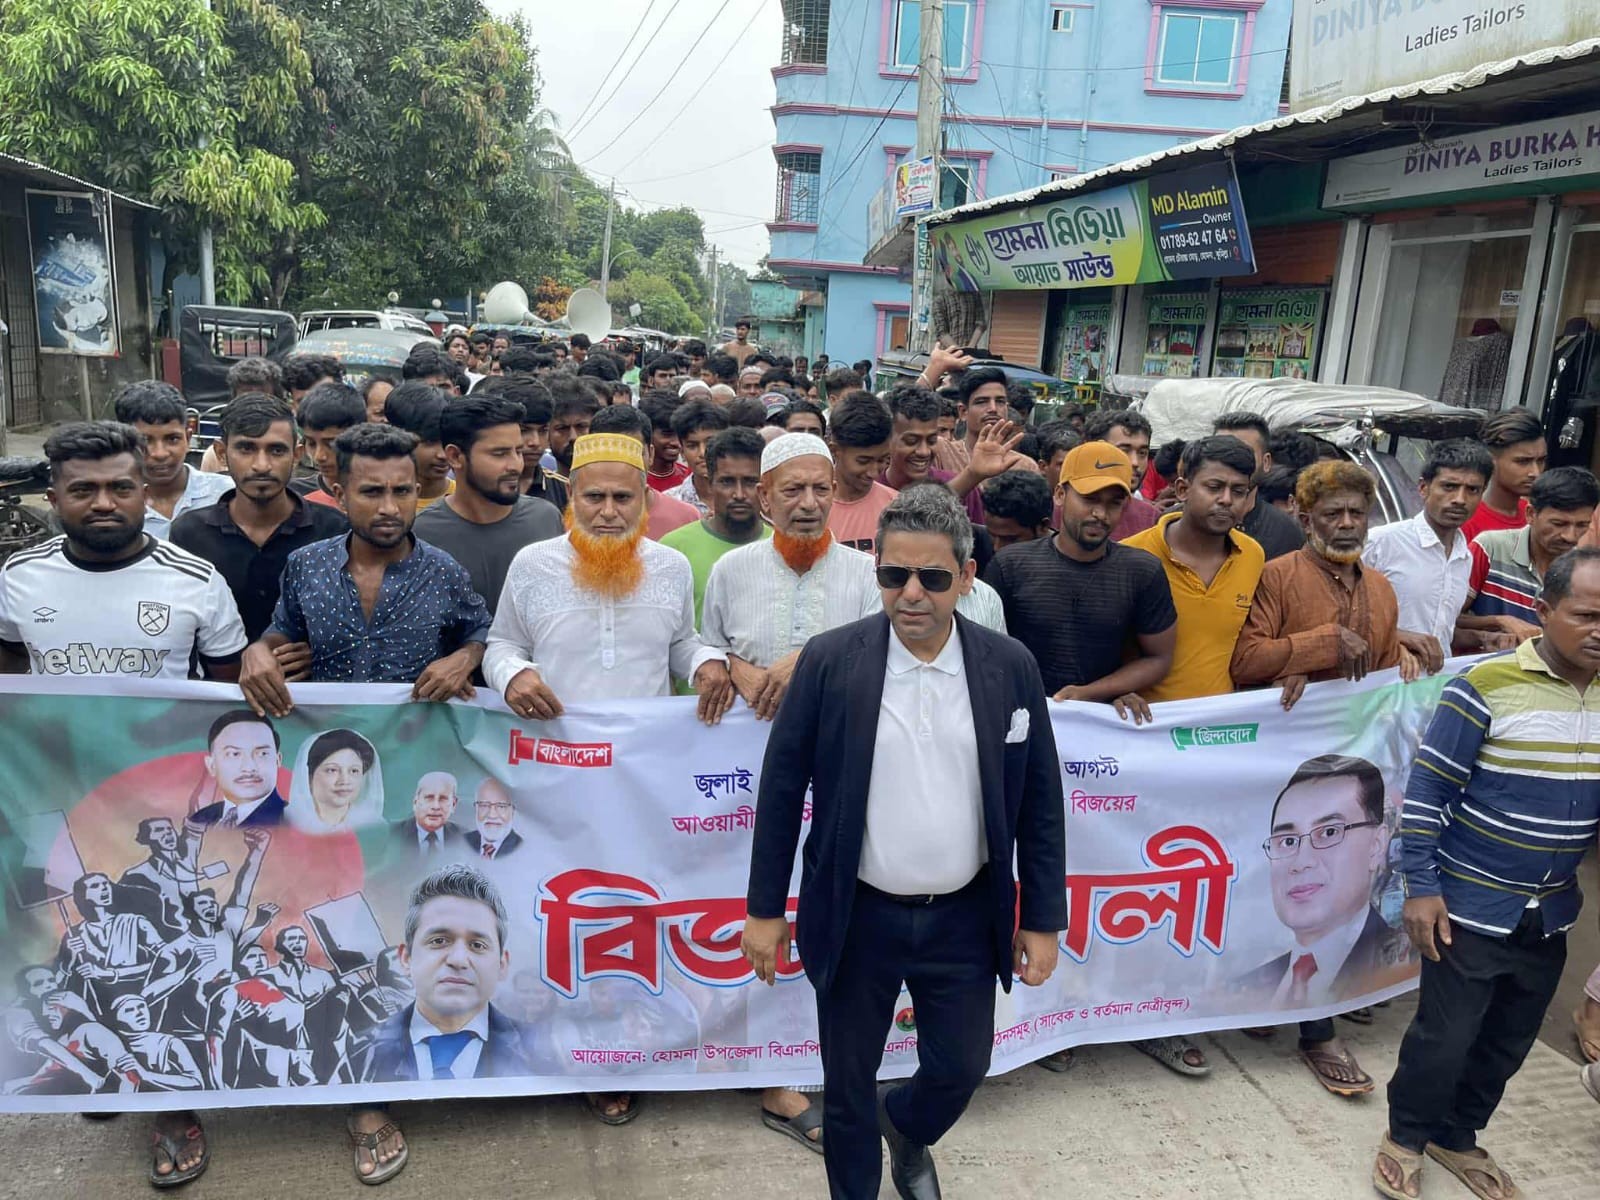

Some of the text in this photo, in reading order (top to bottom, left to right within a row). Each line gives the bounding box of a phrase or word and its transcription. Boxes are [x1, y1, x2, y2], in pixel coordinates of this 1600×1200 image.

[1405, 4, 1525, 53] Ladies Tailors
[1403, 145, 1482, 175] DINIYA
[1488, 129, 1578, 162] BURKA
[1484, 157, 1582, 179] Ladies Tailors
[1152, 185, 1229, 216] MD Alamin
[1202, 212, 1232, 224] Owner
[1046, 205, 1126, 246] মিডিয়া
[1160, 227, 1228, 250] 01789-62 47 64
[1011, 251, 1114, 286] আয়াত সাউন্ড
[1196, 725, 1253, 745] জিন্দাবাদ
[539, 741, 611, 765] বাংলাদেশ
[693, 755, 1119, 800] জুলাই আগস্ট
[672, 789, 1138, 836] আওয়ামী বিজয়ের
[571, 1049, 646, 1065] আয়োজনে:
[652, 1049, 698, 1063] হোমনা
[703, 1044, 763, 1061] উপজেলা
[1034, 1008, 1075, 1034] (সাবেক
[1080, 1009, 1089, 1020] ও
[1094, 1001, 1133, 1017] বর্তমান
